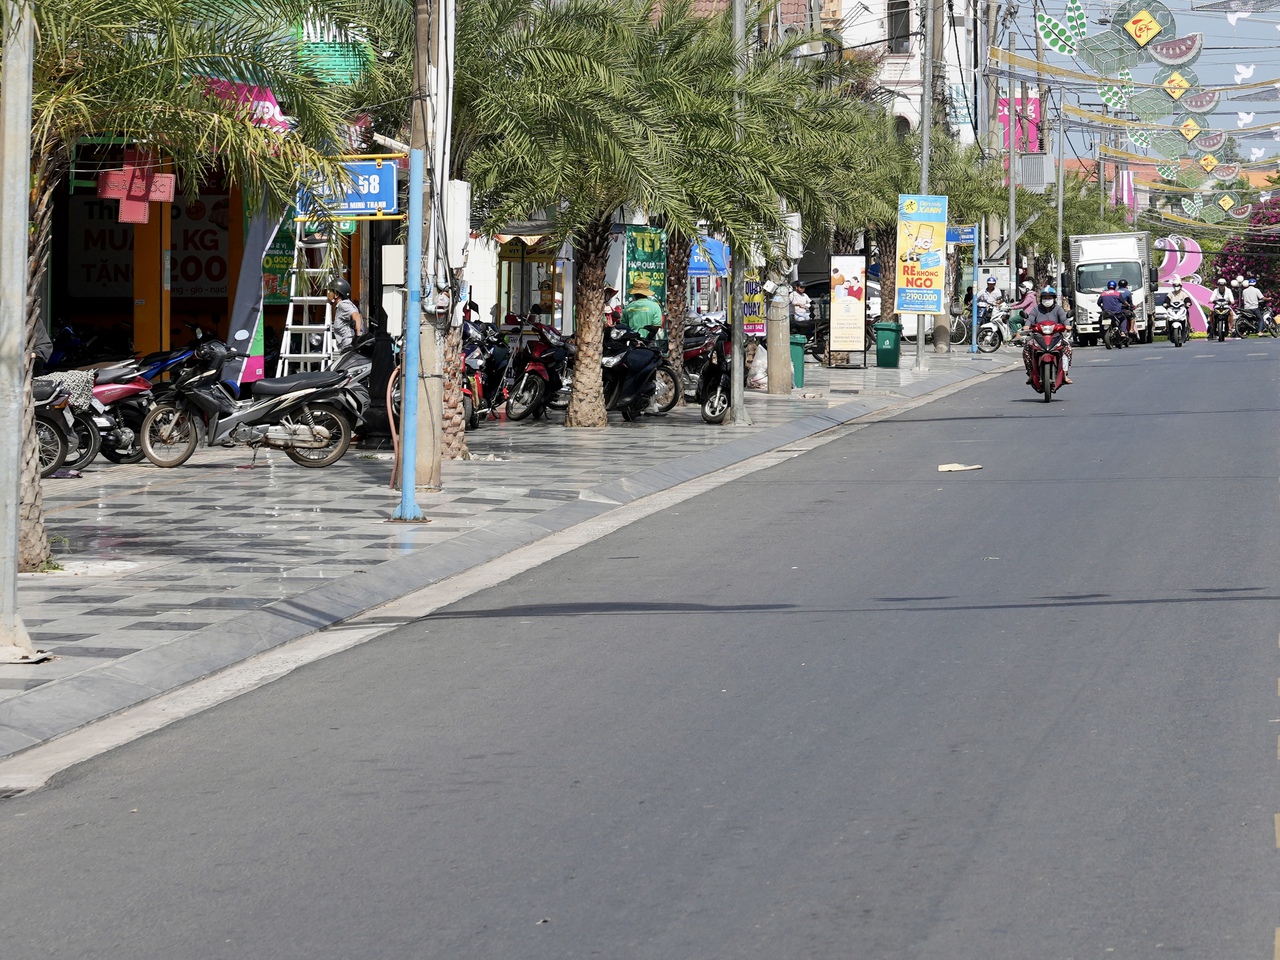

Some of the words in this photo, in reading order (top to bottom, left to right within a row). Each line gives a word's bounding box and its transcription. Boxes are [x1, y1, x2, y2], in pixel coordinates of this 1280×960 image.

[358, 174, 380, 195] 58
[349, 201, 366, 209] MINH
[81, 257, 135, 288] TẶN
